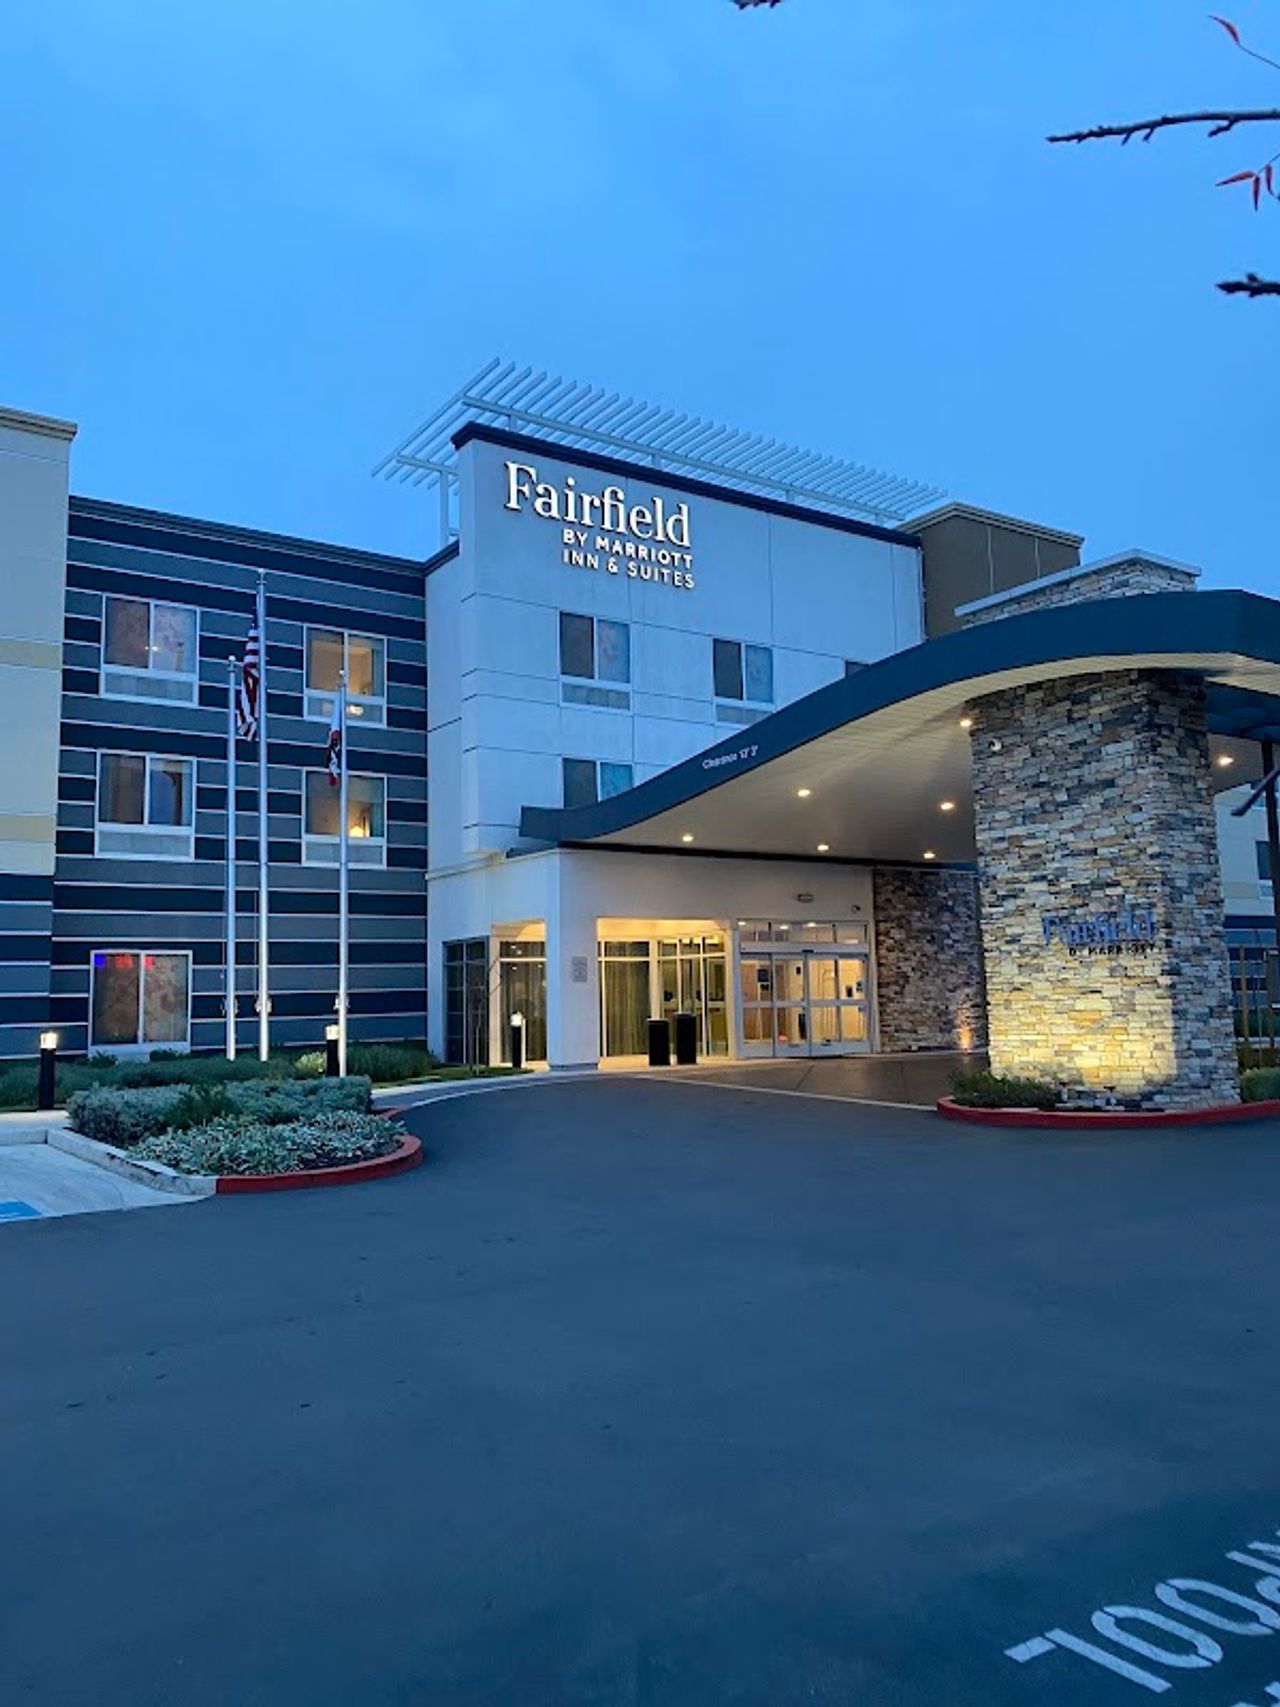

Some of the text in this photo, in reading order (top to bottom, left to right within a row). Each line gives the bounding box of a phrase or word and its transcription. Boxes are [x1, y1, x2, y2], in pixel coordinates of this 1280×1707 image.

[504, 460, 691, 548] Fairfield
[562, 528, 693, 570] BY MARRIOTT
[563, 549, 695, 589] INN & SUITES
[1087, 942, 1155, 957] MARROTT
